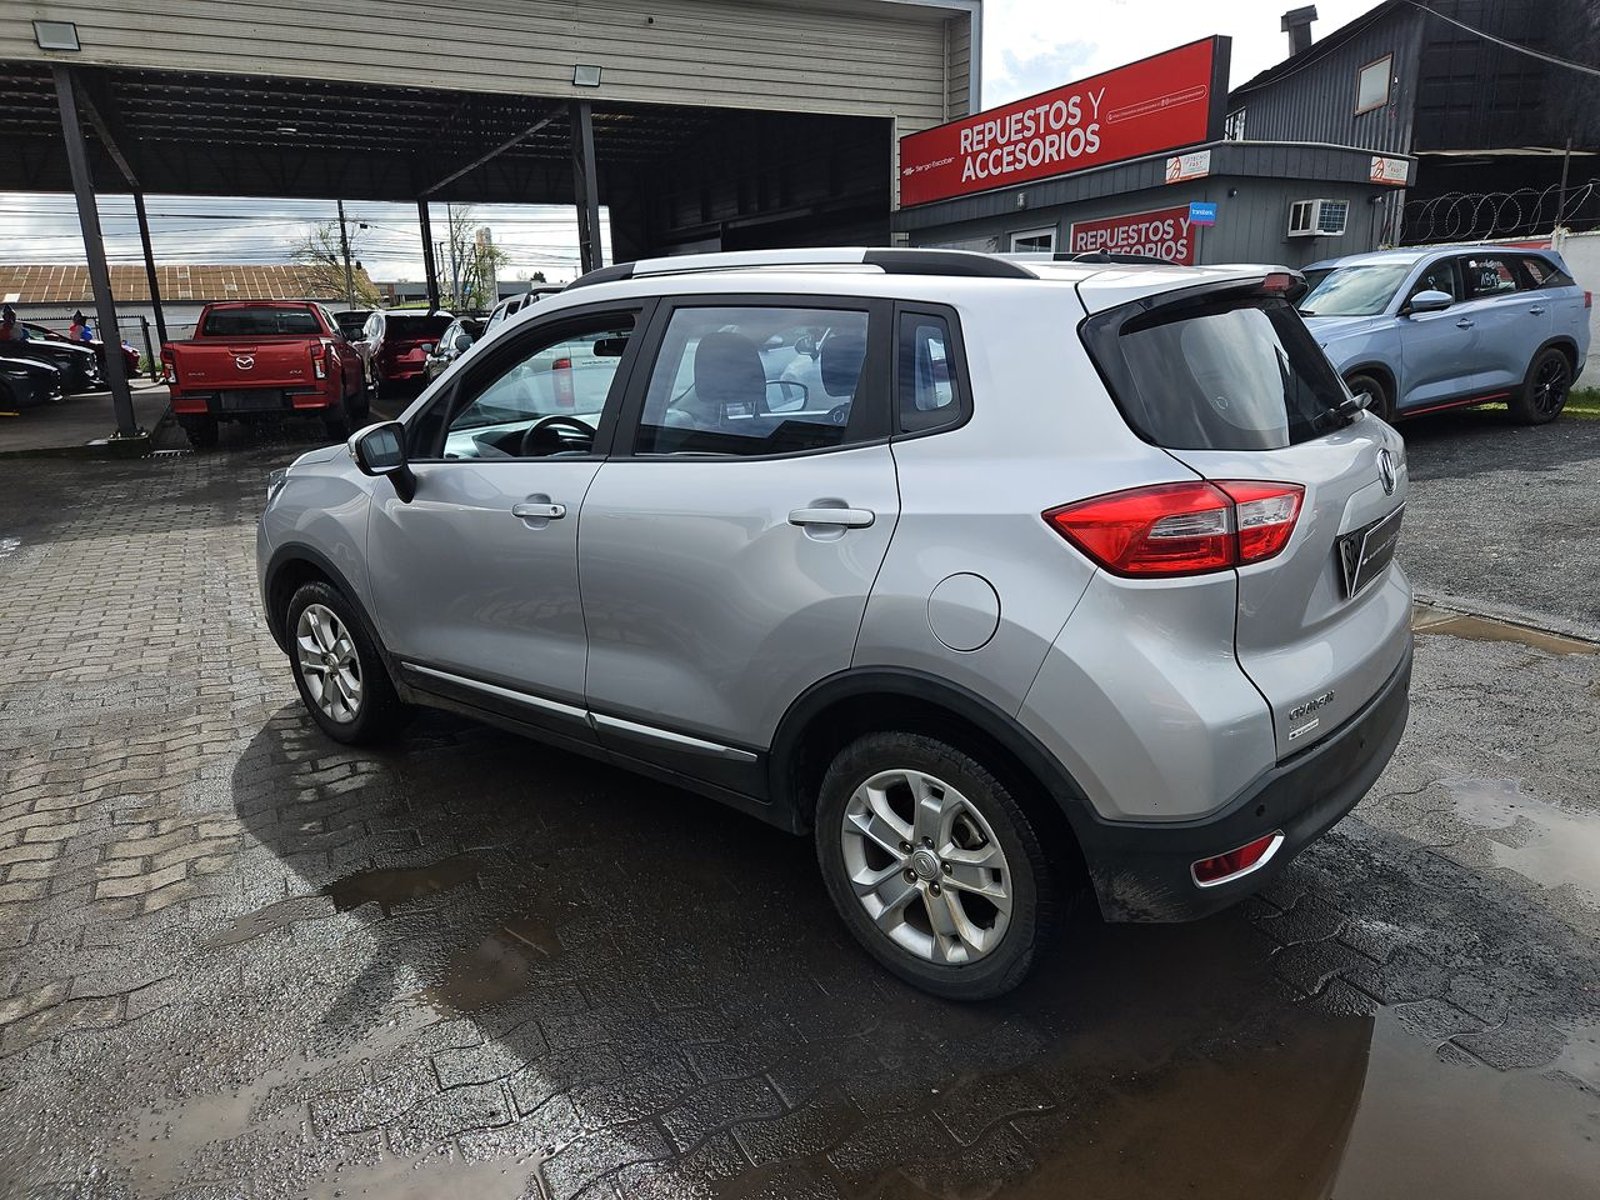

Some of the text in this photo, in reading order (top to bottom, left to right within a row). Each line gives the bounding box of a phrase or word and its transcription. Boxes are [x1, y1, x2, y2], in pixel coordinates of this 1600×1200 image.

[960, 96, 1082, 155] REPUESTOS
[1088, 87, 1106, 120] Y
[961, 123, 1102, 182] ACCESORIOS
[1076, 217, 1191, 251] REPUESTOS Y
